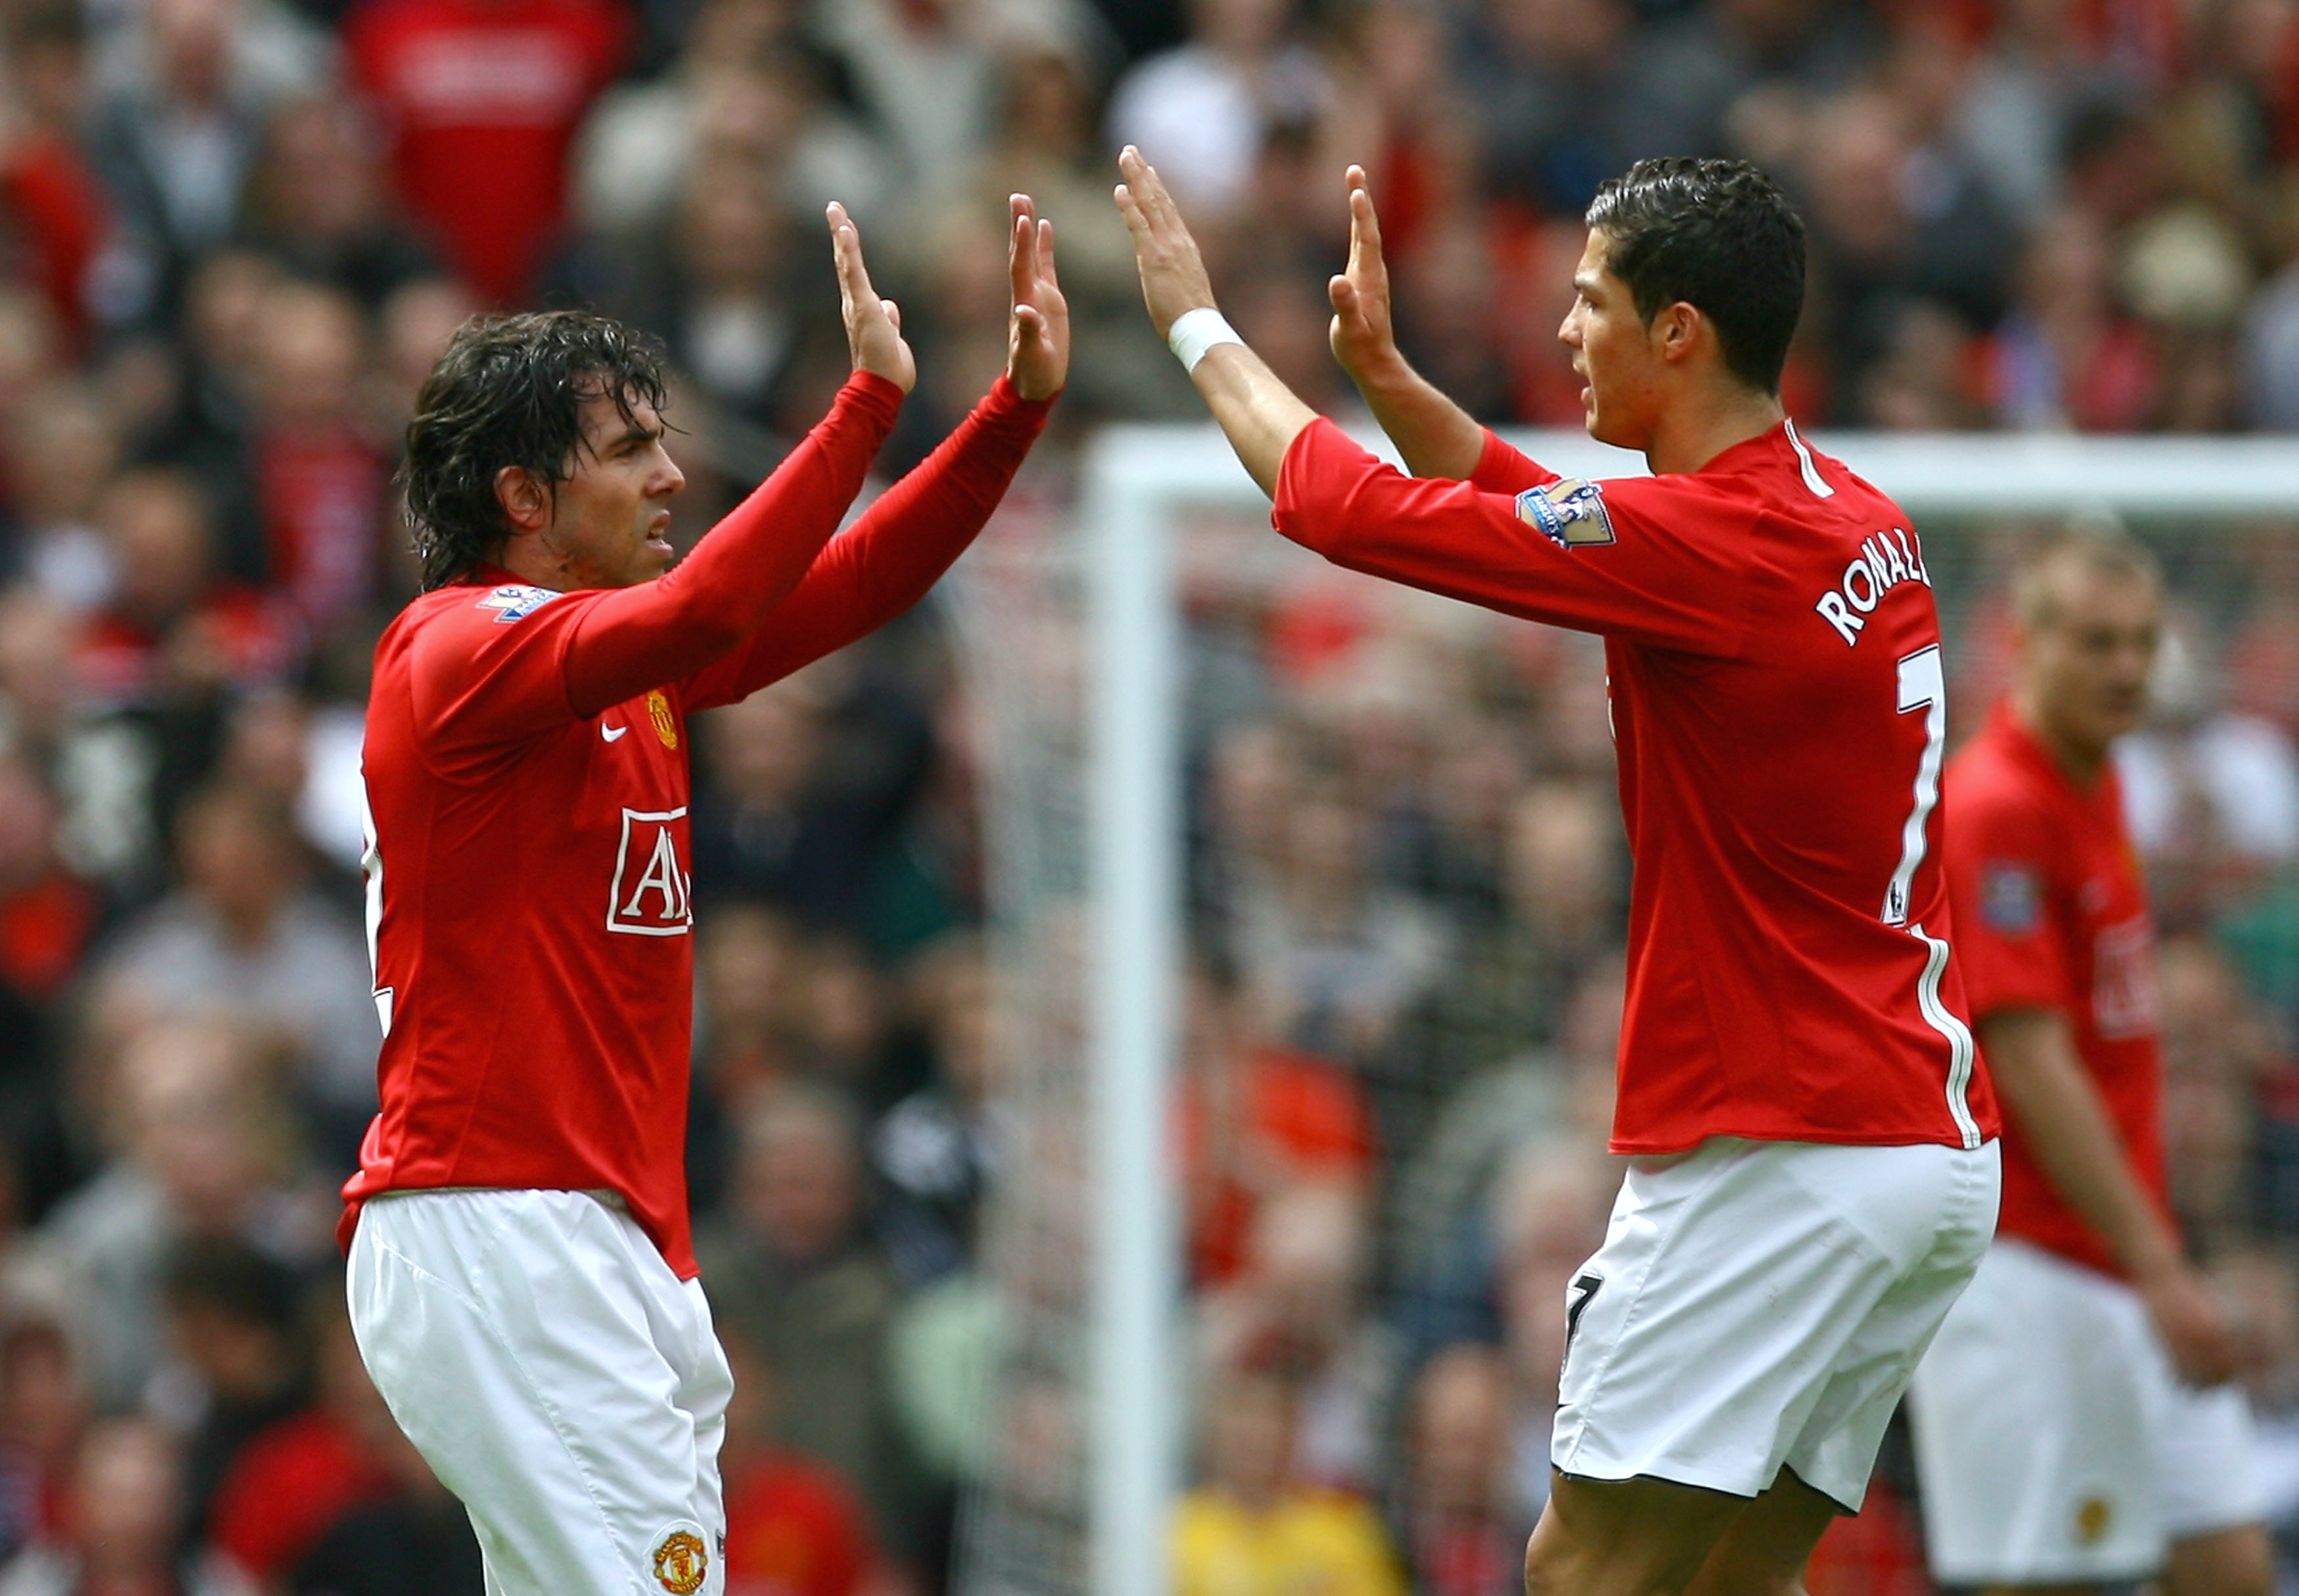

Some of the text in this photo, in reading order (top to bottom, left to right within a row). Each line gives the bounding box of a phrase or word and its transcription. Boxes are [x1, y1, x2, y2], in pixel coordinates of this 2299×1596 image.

[1815, 527, 1932, 647] RONAL
[1880, 643, 1946, 928] 7
[1563, 1274, 1603, 1371] 7
